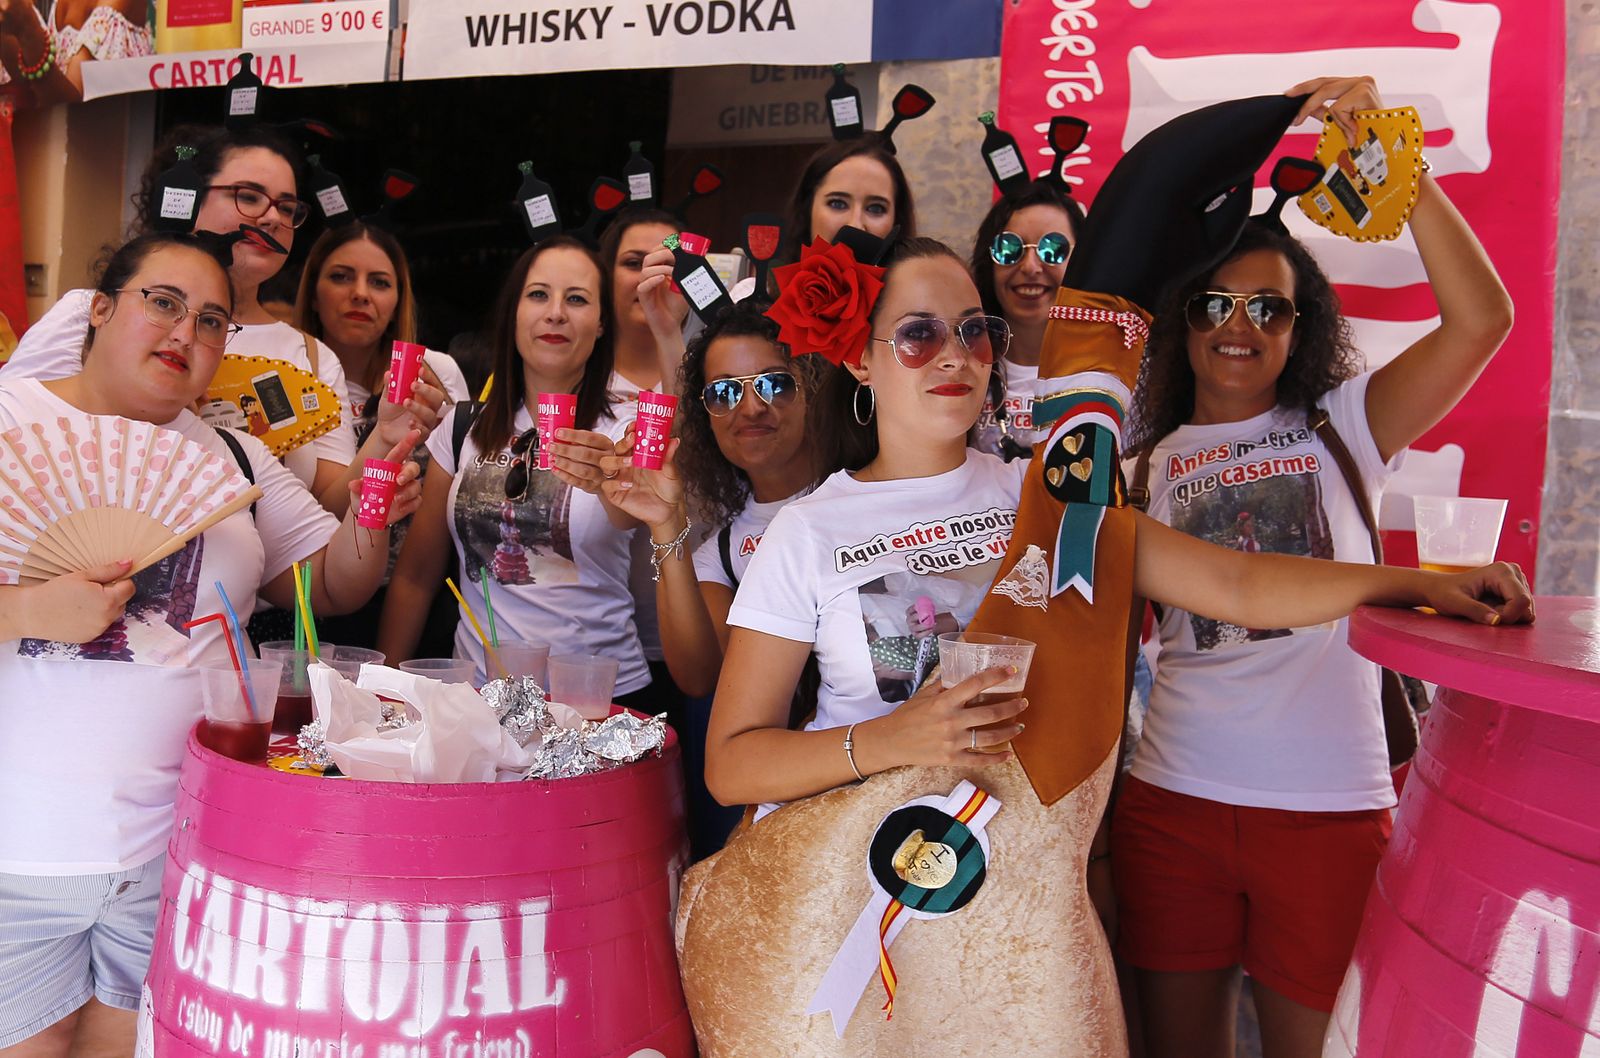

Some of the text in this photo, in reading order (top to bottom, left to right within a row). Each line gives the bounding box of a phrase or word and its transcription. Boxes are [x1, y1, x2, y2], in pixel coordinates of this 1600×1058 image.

[249, 18, 315, 37] GRANDE
[372, 11, 384, 29] €
[465, 5, 613, 48] WHISKY
[645, 0, 796, 37] VODKA
[1168, 443, 1231, 479] Antes
[1175, 455, 1319, 504] que casarme
[840, 538, 887, 567] Aquí
[891, 525, 947, 549] entre
[912, 552, 961, 572] ¿Que
[962, 545, 985, 562] le
[171, 864, 568, 1036] CARTOJAL
